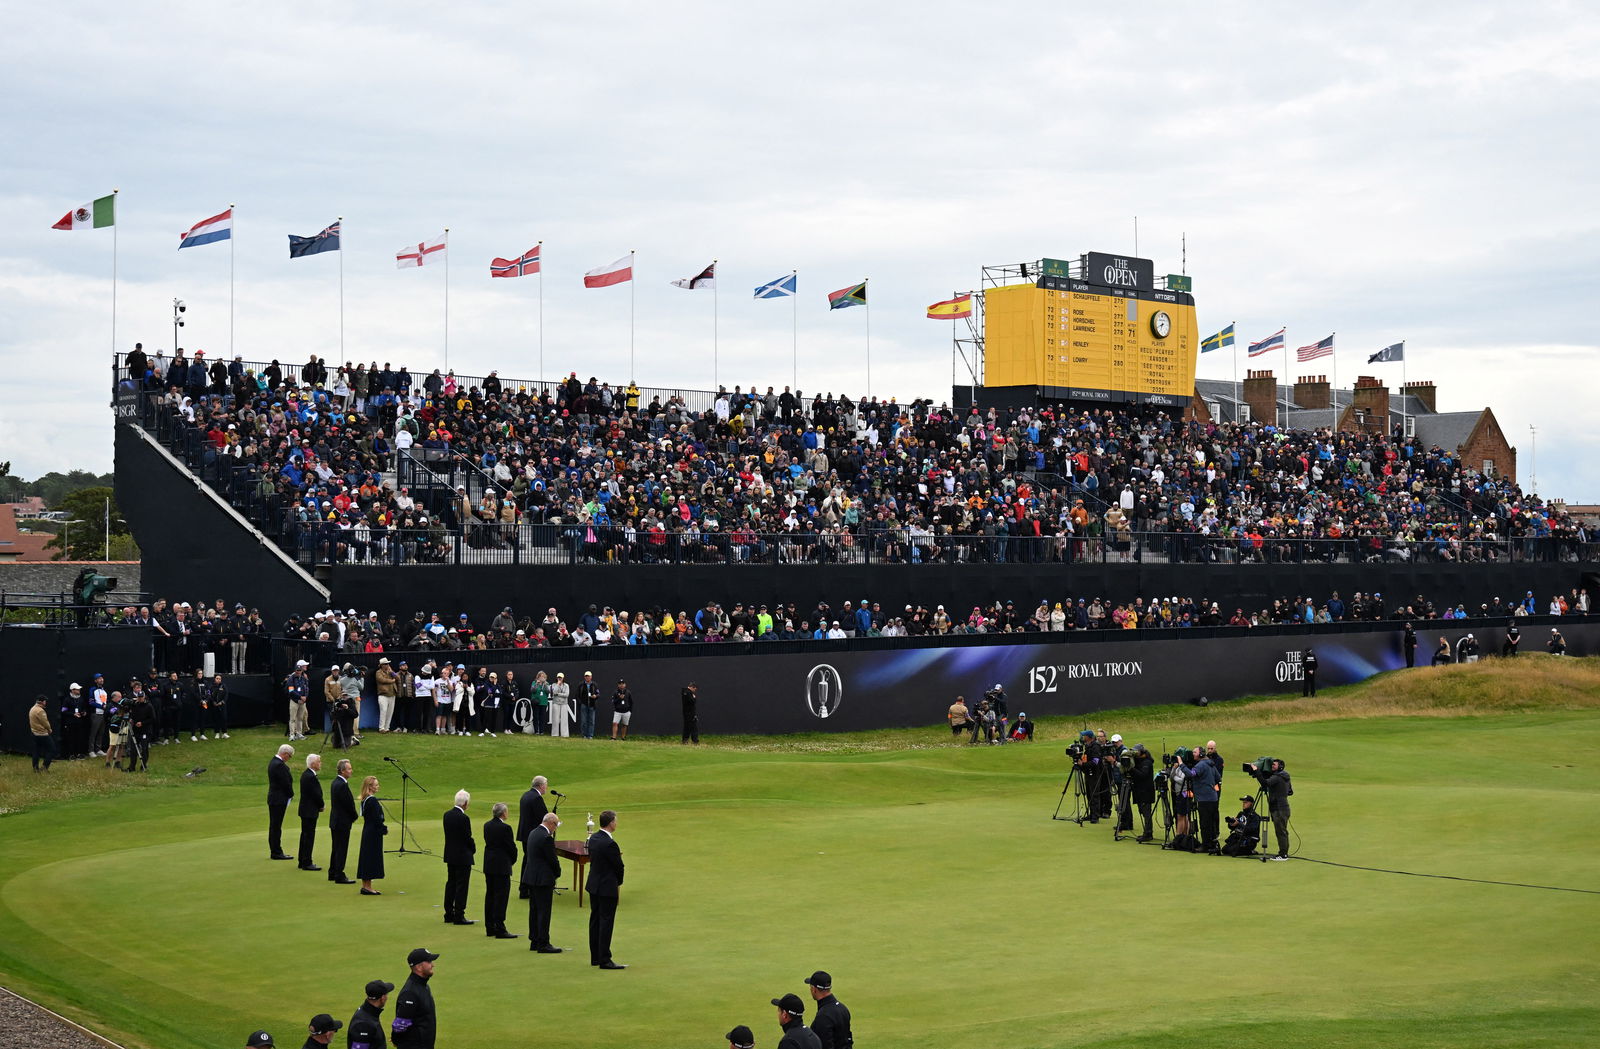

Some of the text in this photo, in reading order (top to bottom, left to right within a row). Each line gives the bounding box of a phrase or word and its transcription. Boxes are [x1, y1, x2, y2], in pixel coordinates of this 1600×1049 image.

[1114, 258, 1128, 269] THE
[1104, 265, 1137, 286] OPEN
[1128, 329, 1135, 337] 71
[1286, 651, 1302, 662] THE
[1068, 664, 1102, 679] ROYAL
[1104, 661, 1142, 677] TROON
